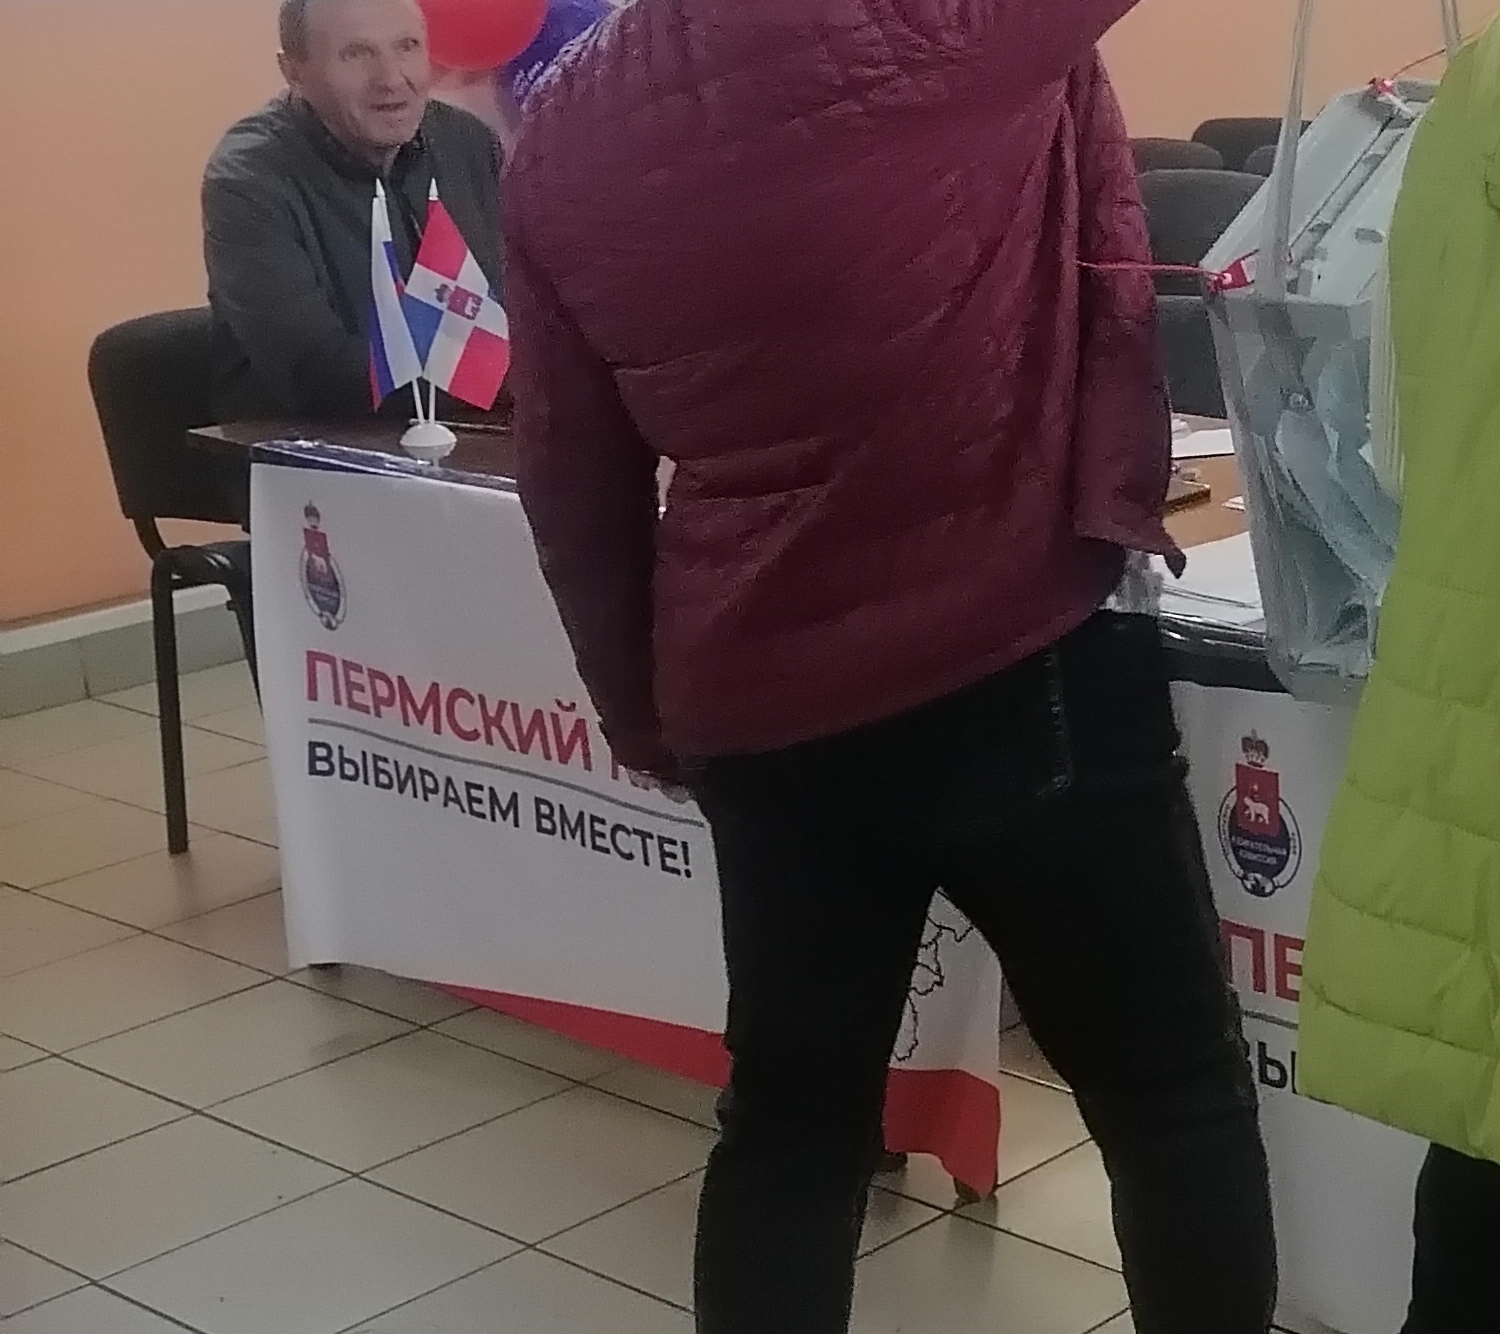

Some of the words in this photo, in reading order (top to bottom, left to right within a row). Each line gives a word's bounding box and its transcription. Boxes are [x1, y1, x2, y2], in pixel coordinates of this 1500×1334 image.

[305, 650, 593, 772] ПЕРМСКИЙ
[307, 740, 521, 829] ВЫБИРАЕМ
[533, 796, 692, 879] ВМЕСТЕ!
